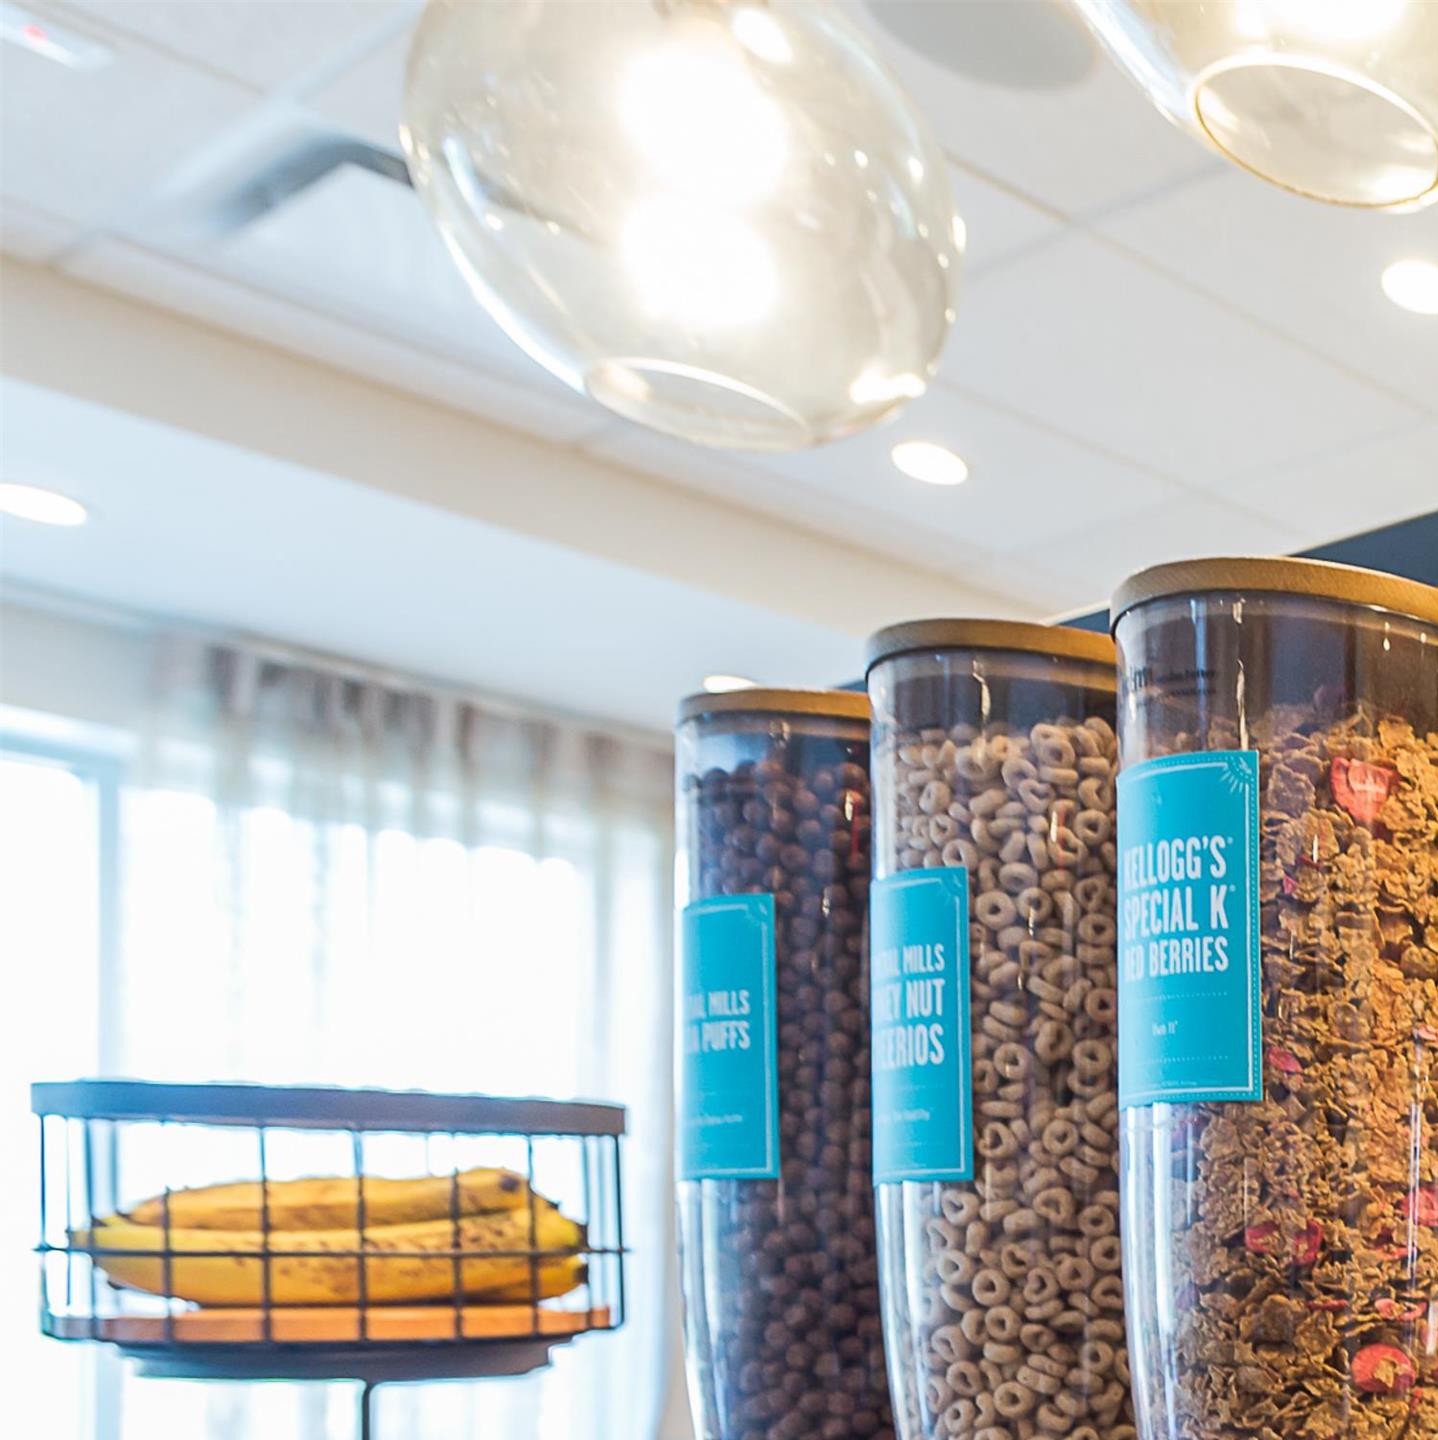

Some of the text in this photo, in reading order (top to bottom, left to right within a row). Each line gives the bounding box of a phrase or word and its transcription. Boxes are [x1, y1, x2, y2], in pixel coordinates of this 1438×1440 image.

[1123, 883, 1229, 943] SPECIAL K
[903, 943, 946, 975] MILLS
[1148, 935, 1229, 977] BERRIES
[708, 989, 751, 1016] MILLS
[906, 978, 946, 1018] NUT
[701, 1020, 751, 1053] PUFFS
